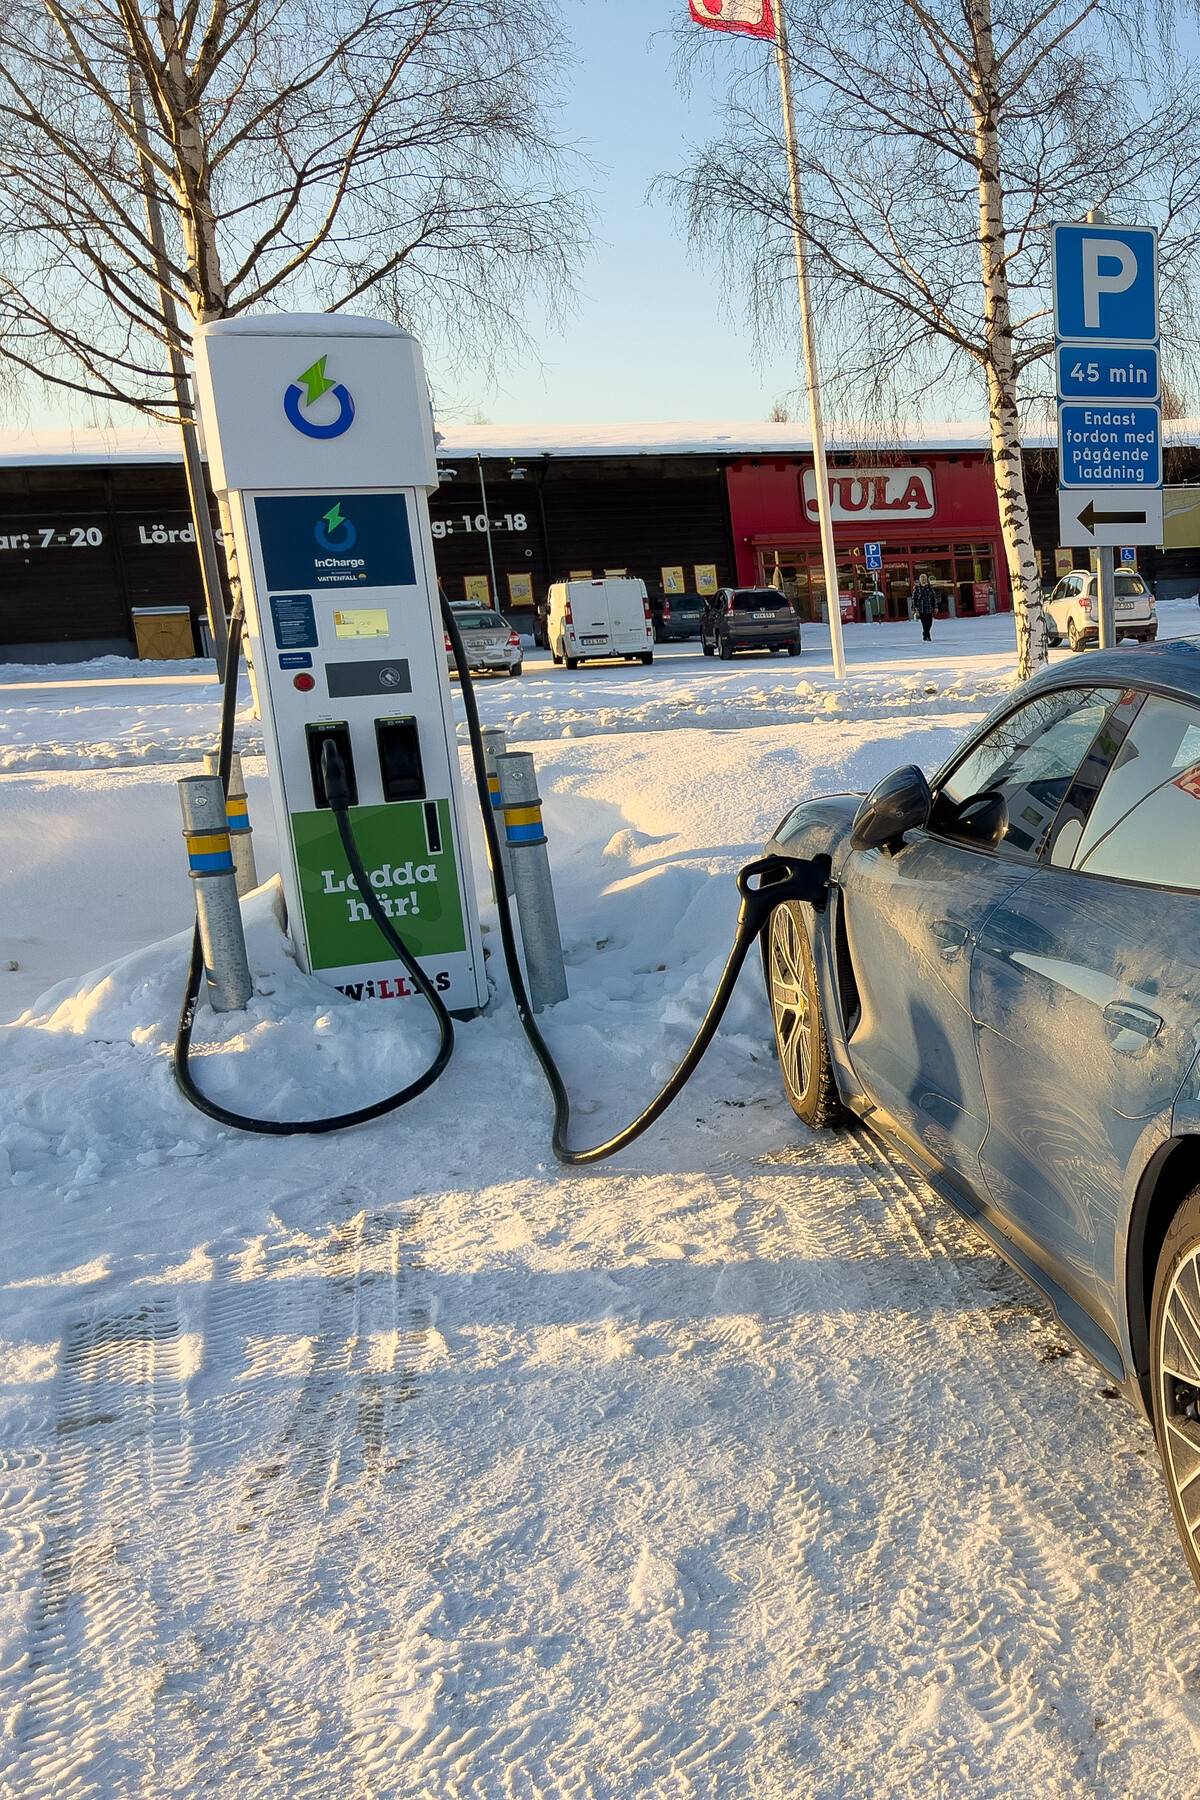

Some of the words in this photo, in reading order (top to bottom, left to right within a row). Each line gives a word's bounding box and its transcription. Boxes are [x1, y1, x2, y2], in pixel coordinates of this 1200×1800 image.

[1082, 238, 1138, 328] P
[1070, 362, 1100, 382] 45
[1109, 364, 1148, 383] min
[1084, 411, 1136, 425] Endast
[1066, 429, 1118, 443] fordon
[1124, 430, 1155, 443] med
[1073, 447, 1149, 463] pågående
[1079, 465, 1144, 481] laddning
[806, 475, 933, 512] JULA
[462, 513, 528, 532] 10-18
[38, 527, 103, 549] 7-20
[870, 545, 876, 555] P
[314, 558, 365, 568] InCharge
